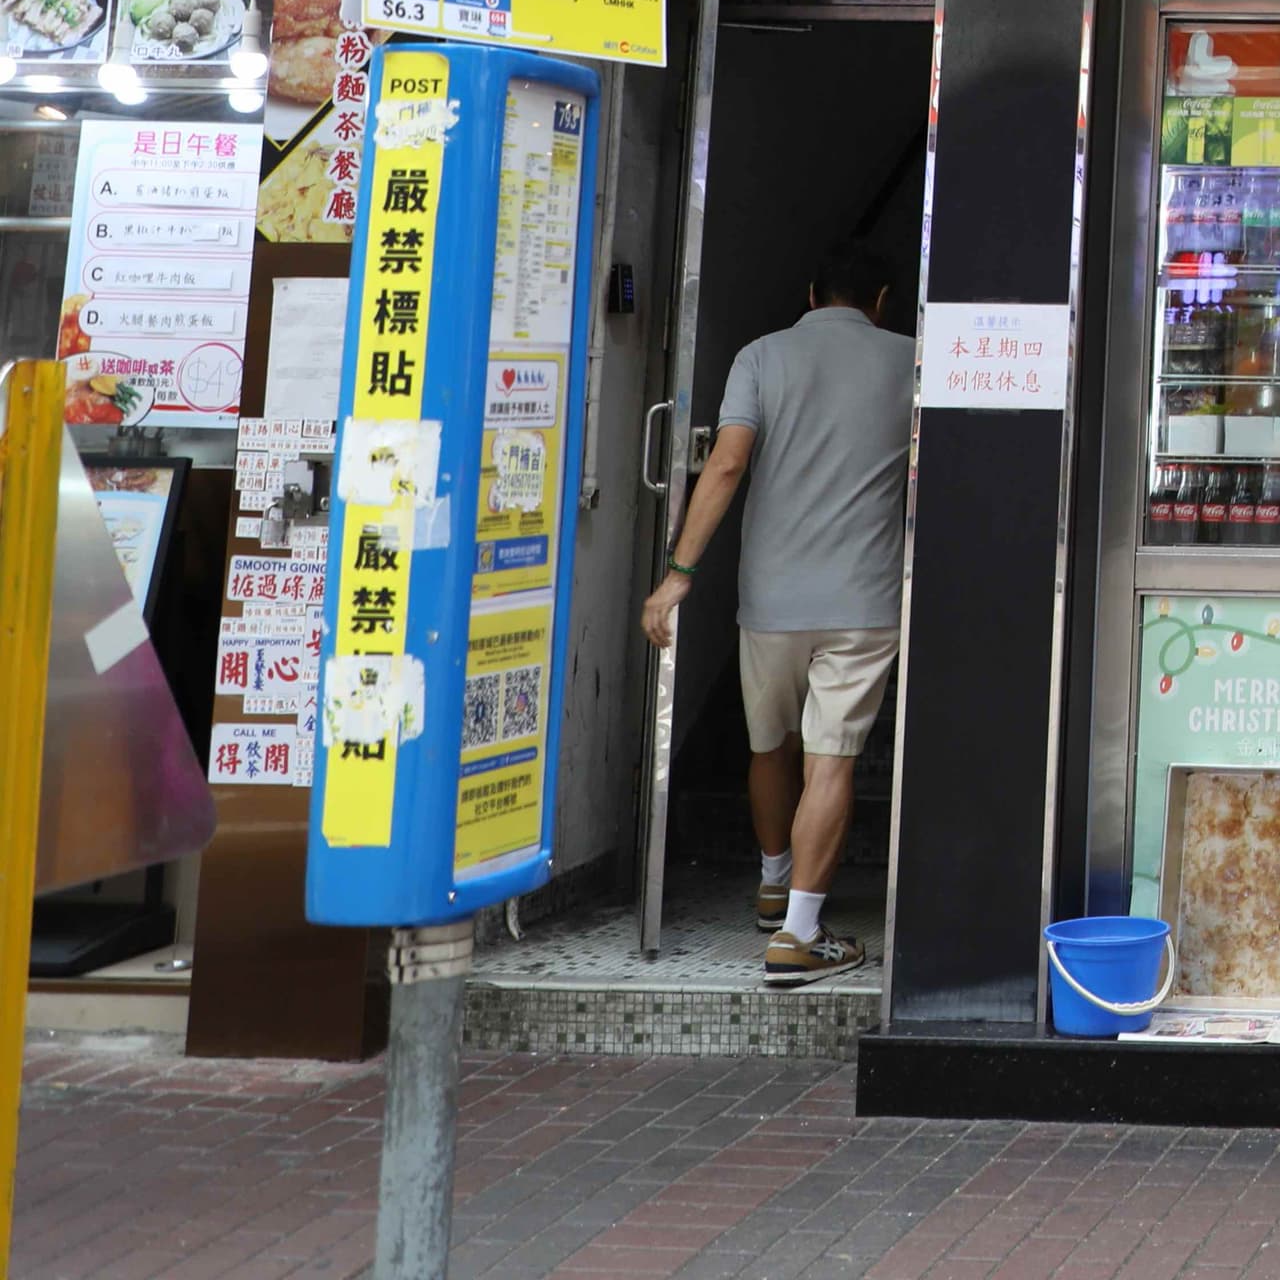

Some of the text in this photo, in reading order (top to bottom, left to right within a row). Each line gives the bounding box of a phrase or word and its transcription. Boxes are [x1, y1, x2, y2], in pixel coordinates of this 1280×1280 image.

[389, 77, 443, 95] POST
[327, 34, 368, 219] 粉麵茶餐廳
[558, 107, 578, 131] 793
[132, 129, 239, 158] 是日午餐
[100, 180, 118, 196] A.
[96, 223, 113, 239] B.
[368, 169, 430, 397] 嚴禁標貼
[86, 310, 104, 326] D.
[948, 335, 1043, 359] 本星期四
[946, 370, 1042, 393] 例假休息
[234, 559, 287, 573] SMOOTH
[222, 638, 301, 647] HAPPY IMPORTANT
[220, 651, 300, 689] 開 心
[233, 728, 277, 738] CALL ME
